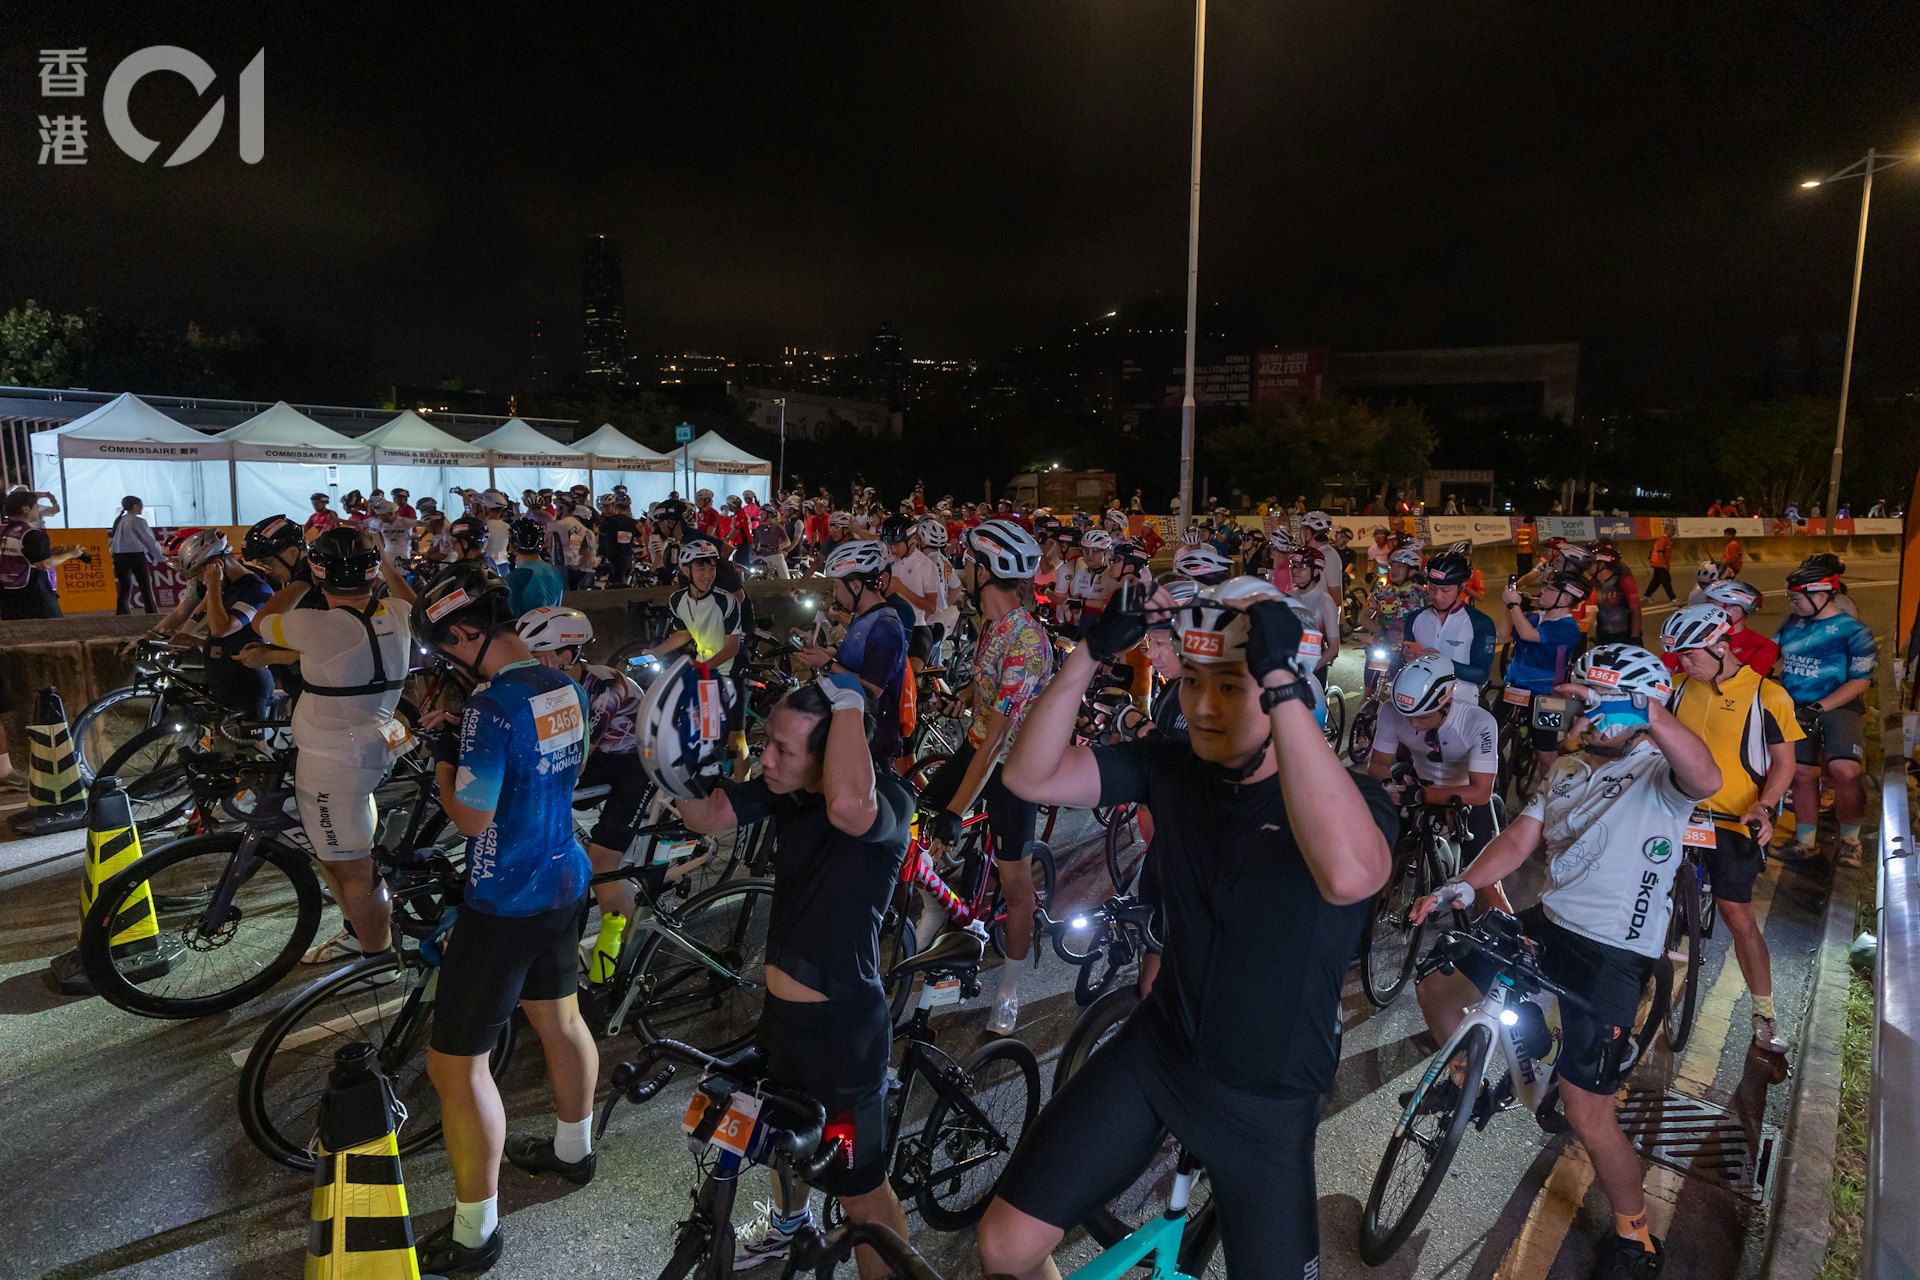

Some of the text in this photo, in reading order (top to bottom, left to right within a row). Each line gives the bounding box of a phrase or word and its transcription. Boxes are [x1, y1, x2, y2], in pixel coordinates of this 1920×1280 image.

[1258, 361, 1309, 375] JAZZ FEST
[100, 445, 177, 455] COMMISSAIRE
[265, 450, 329, 459] COMMISSAIRE
[383, 450, 409, 458] TIMING
[418, 451, 449, 459] RESULT
[1561, 519, 1580, 529] bon
[1563, 529, 1586, 538] aqua
[64, 572, 104, 581] HONG
[66, 580, 106, 589] KONG
[1185, 633, 1220, 652] 2725
[1783, 653, 1823, 666] BANFF
[1588, 668, 1616, 683] 3361
[1397, 693, 1415, 705] 2768
[547, 708, 579, 734] 2466
[459, 707, 471, 761] MONDIALE
[465, 707, 481, 753] AG2R LA
[317, 791, 340, 846] Alex Chow TK
[1684, 830, 1707, 842] 585
[470, 830, 487, 888] ONDIALE
[480, 857, 496, 879] LA
[1624, 868, 1660, 942] ŠKODA
[1508, 1027, 1537, 1086] ERIDA
[717, 1113, 741, 1138] 26
